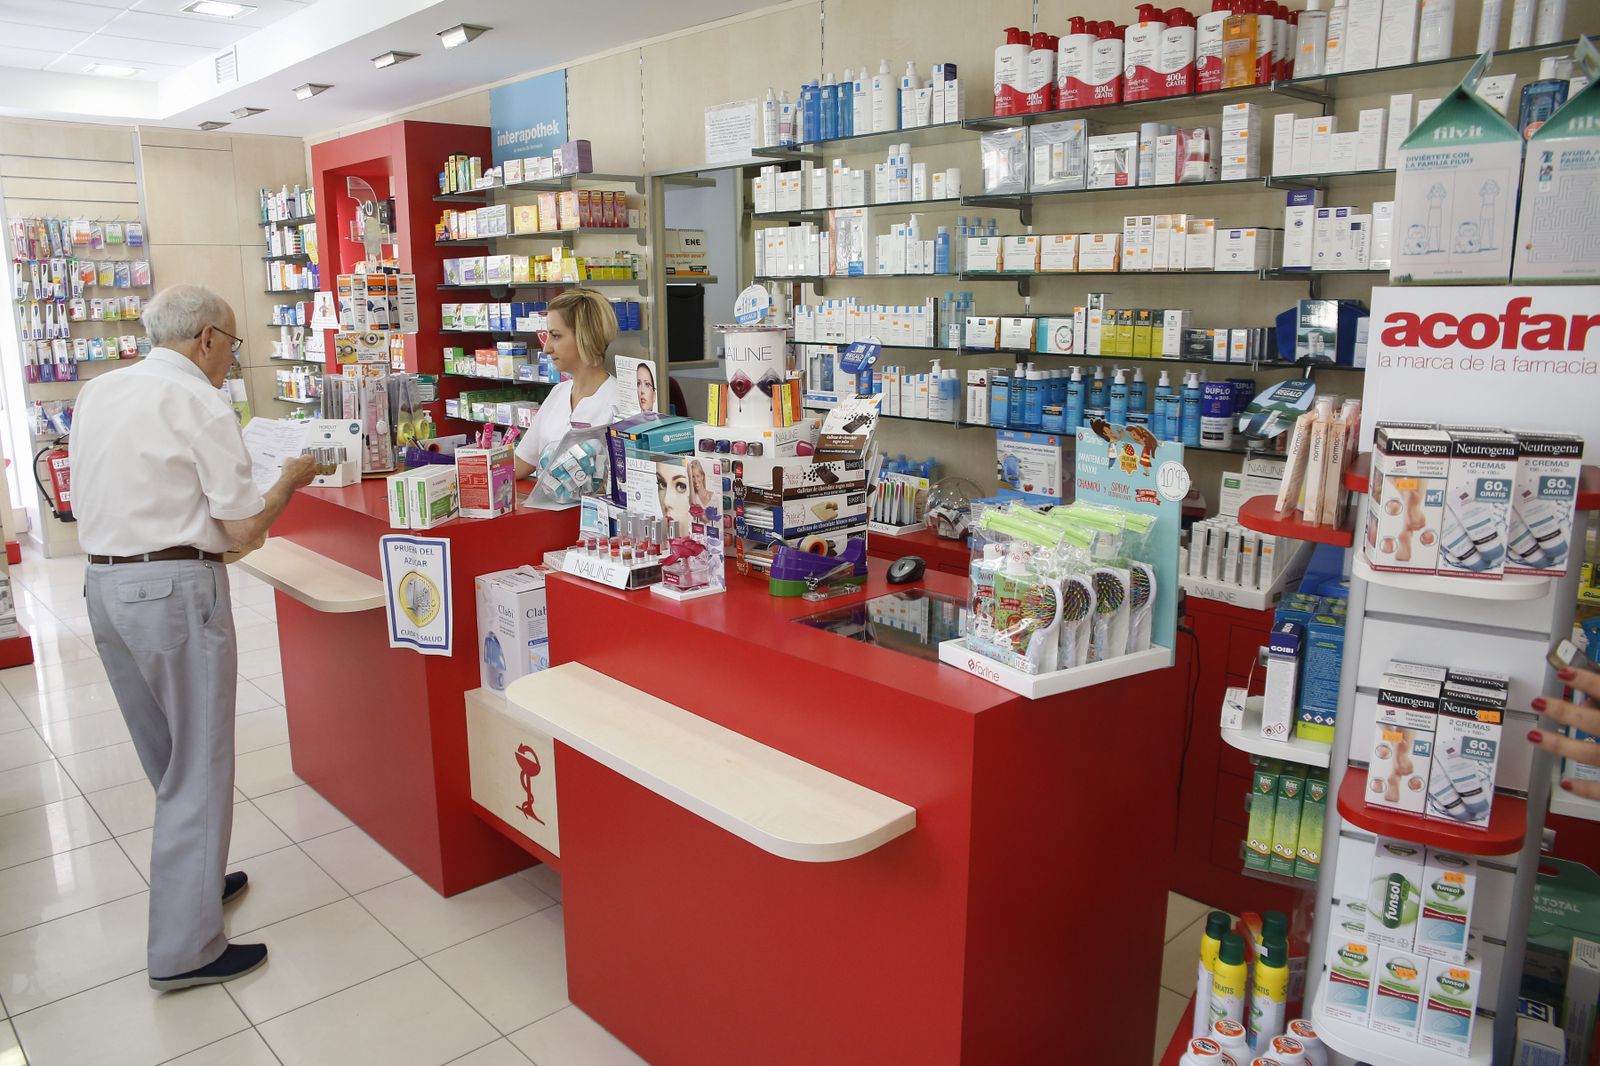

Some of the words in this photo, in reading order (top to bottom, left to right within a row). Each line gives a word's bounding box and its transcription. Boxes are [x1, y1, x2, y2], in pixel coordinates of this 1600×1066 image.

[1165, 80, 1187, 88] GRATIS
[496, 119, 561, 146] interapothek
[1432, 124, 1485, 141] filvit
[1405, 153, 1450, 162] DIVIÉRTETE
[1560, 150, 1590, 158] AYUDA
[1418, 160, 1449, 168] FAMILIA
[1560, 157, 1595, 165] FAMILIA
[1380, 296, 1600, 351] acofar
[725, 345, 773, 362] AILINE
[1377, 351, 1391, 368] la
[1397, 355, 1454, 371] marca
[1459, 354, 1485, 372] de
[1490, 355, 1506, 373] la
[1512, 356, 1599, 375] farmacia
[1205, 386, 1231, 396] DUPLO
[1391, 440, 1447, 455] Neutrogena
[1456, 442, 1515, 458] Neutrogena
[1519, 441, 1579, 455] Neutrogena
[1247, 462, 1285, 475] NAILINE
[1469, 461, 1506, 470] CREMAS
[1531, 459, 1570, 468] CREMAS
[1479, 490, 1506, 498] GRATIS
[1543, 488, 1570, 496] GRATIS
[419, 548, 435, 556] DEL
[573, 558, 616, 584] NAILINE
[1194, 585, 1237, 602] NAILINE
[497, 603, 515, 620] Clabi
[420, 635, 443, 643] SALUD
[1270, 645, 1294, 654] GOIBI
[974, 661, 1001, 683] farline
[1381, 691, 1436, 709] Neutrogena
[1443, 701, 1480, 719] Neutrog
[1455, 720, 1491, 732] CREMAS
[1465, 748, 1491, 758] GRATIS
[1436, 884, 1461, 895] funsol
[1384, 881, 1401, 921] funsol
[1541, 896, 1581, 913] TOTAL
[1342, 950, 1364, 961] funsol
[1441, 977, 1466, 989] funsol
